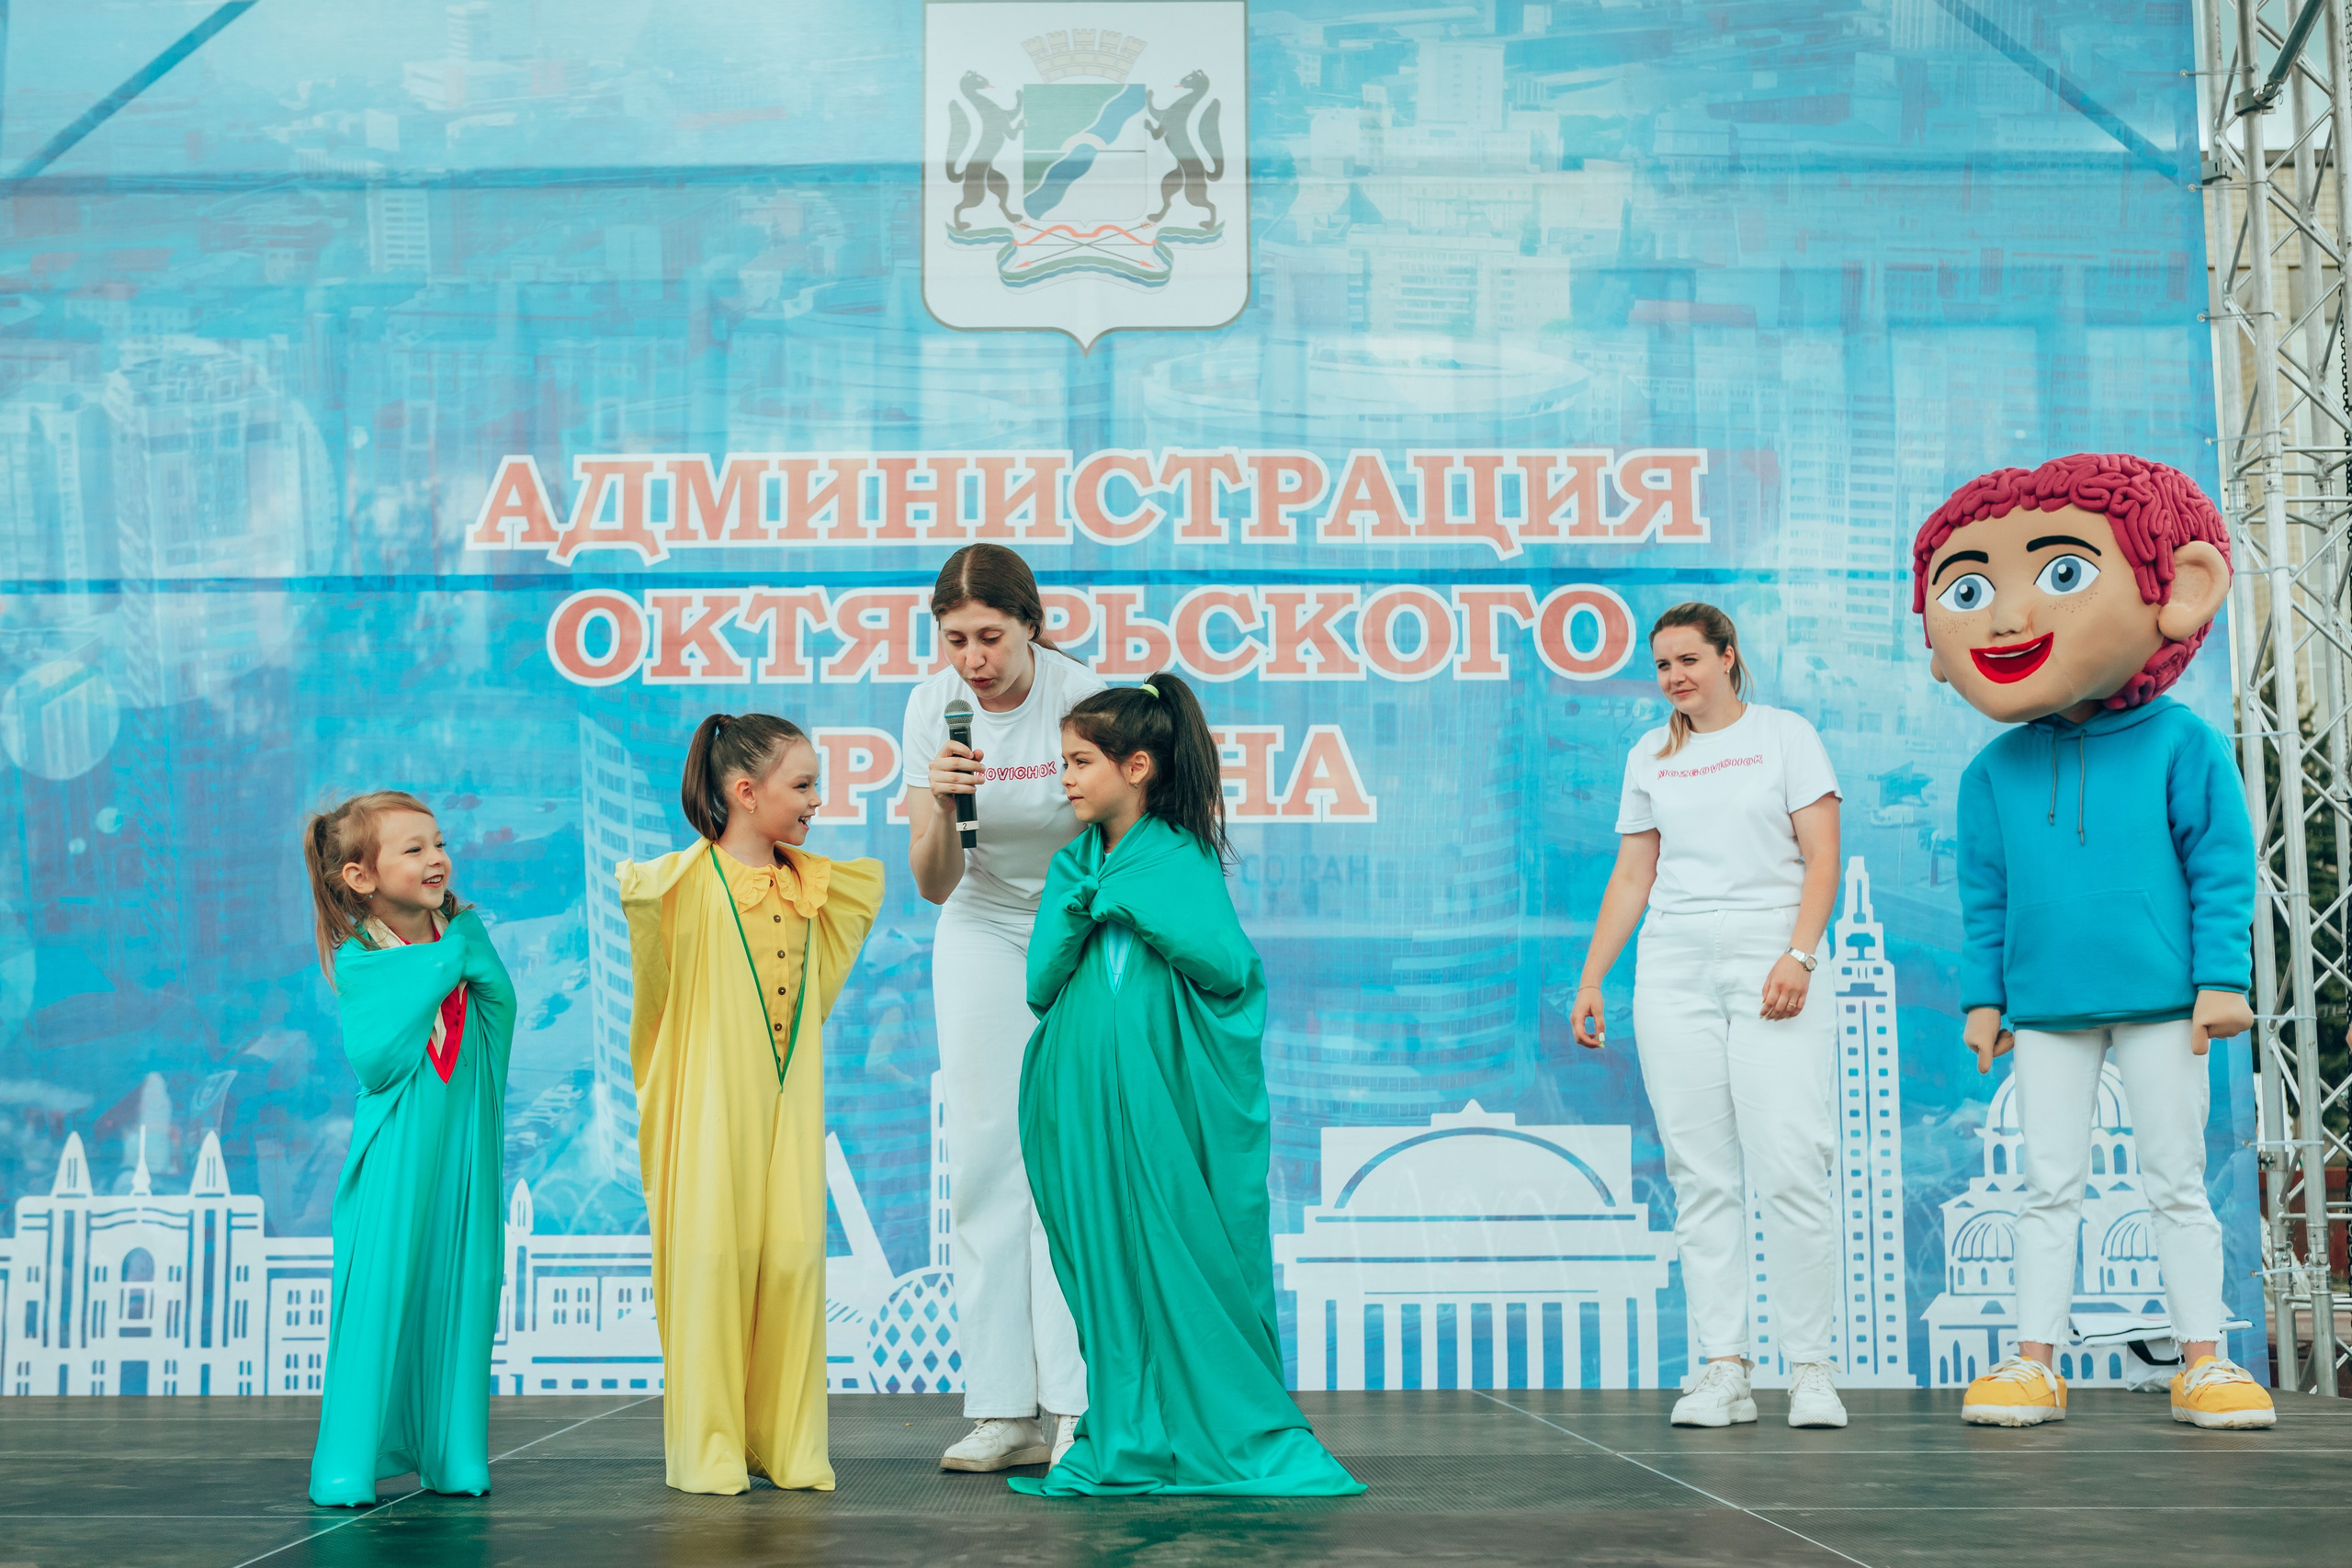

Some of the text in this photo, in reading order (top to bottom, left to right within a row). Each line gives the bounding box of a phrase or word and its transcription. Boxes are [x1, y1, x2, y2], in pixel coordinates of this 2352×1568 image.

[466, 448, 1711, 566] АДМИНИСТРАЦИЯ
[547, 583, 1636, 686] ОКТЯРЬСКОГО
[974, 761, 1057, 781] OVICHOK
[1657, 754, 1763, 780] MOZGOVICHOK
[1301, 854, 1369, 886] РАН
